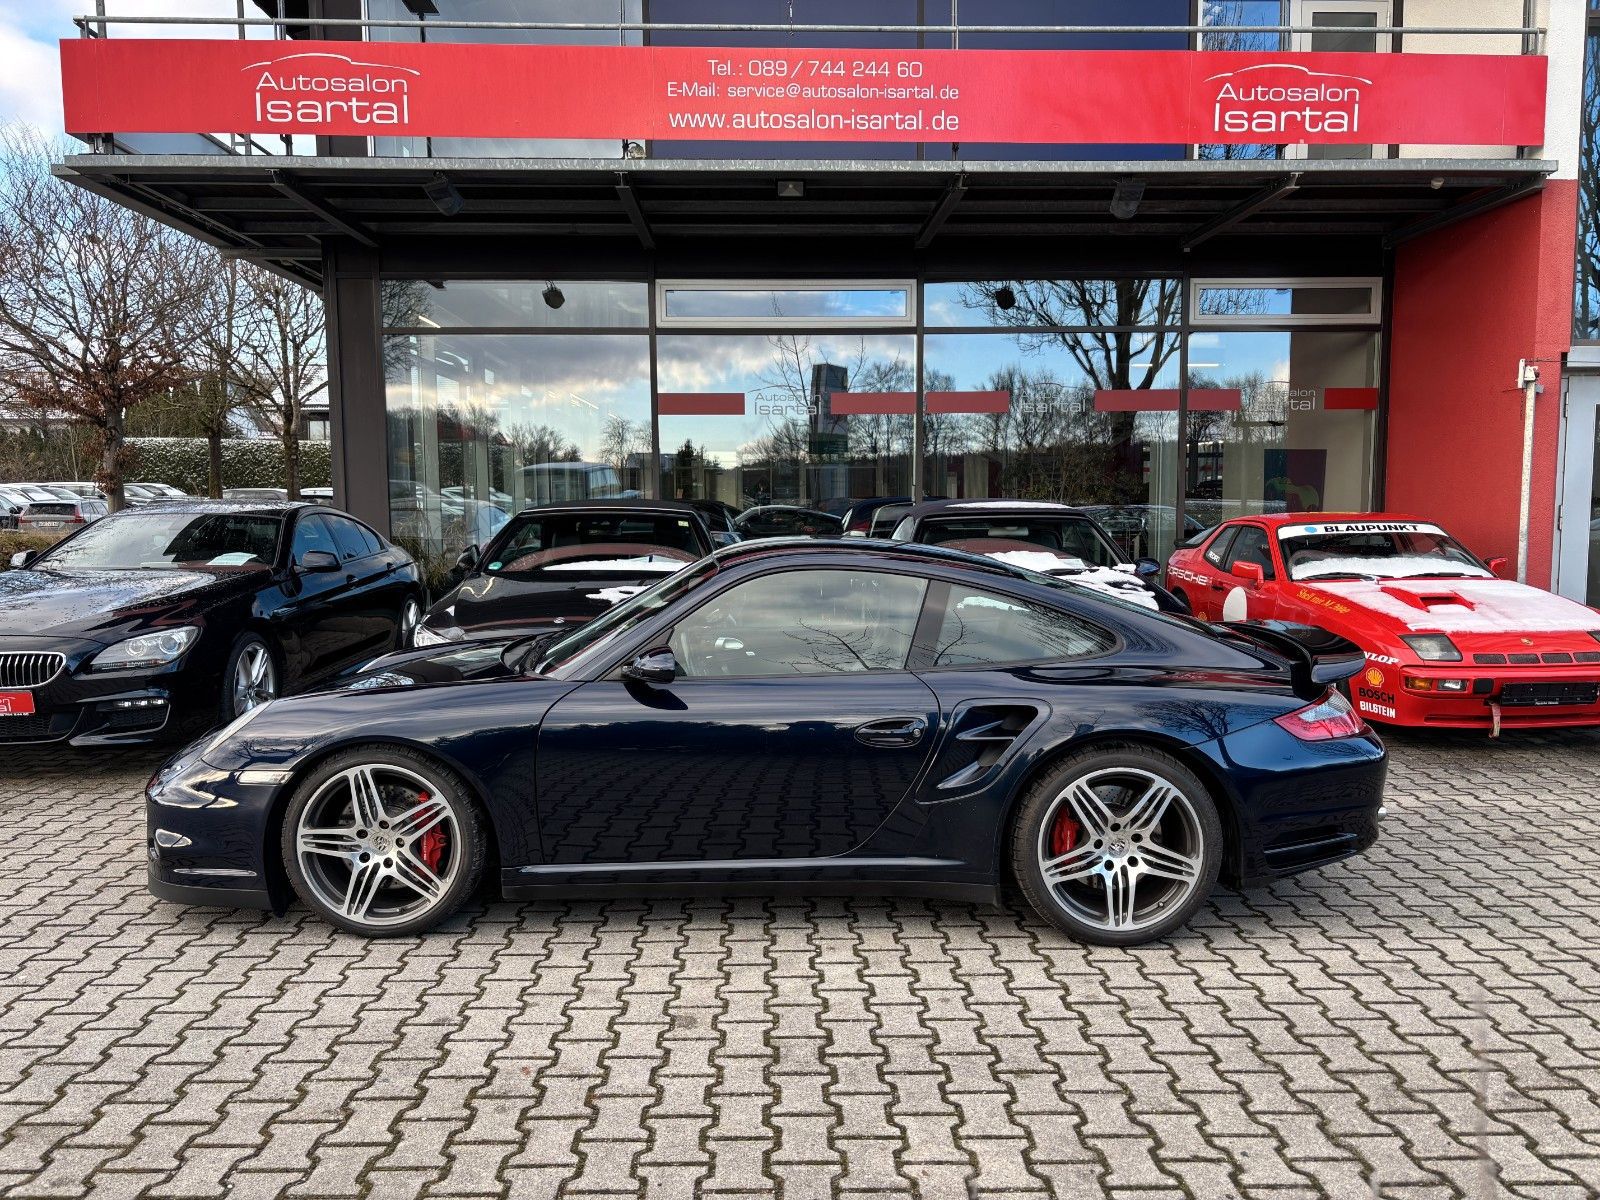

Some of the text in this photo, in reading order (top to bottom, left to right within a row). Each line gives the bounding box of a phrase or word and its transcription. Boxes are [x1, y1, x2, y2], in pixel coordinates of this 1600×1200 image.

[748, 60, 787, 77] 089
[790, 60, 803, 78] /
[808, 60, 846, 77] 744
[852, 61, 891, 77] 244
[897, 61, 923, 78] 60
[256, 71, 408, 93] Autosalon
[667, 82, 960, 100] E-Mail: service@autosalon-isartal.de
[1216, 82, 1360, 102] Autosalon
[255, 92, 409, 125] Isartal
[1213, 102, 1360, 133] Isartal
[668, 108, 960, 132] www.autosalon-isartal.de
[754, 401, 822, 415] Isartal
[1323, 524, 1419, 533] BLAUPUNKT
[1363, 651, 1400, 665] NLOP
[1358, 687, 1395, 704] BOSCH
[1360, 701, 1396, 718] BILSTEIN
